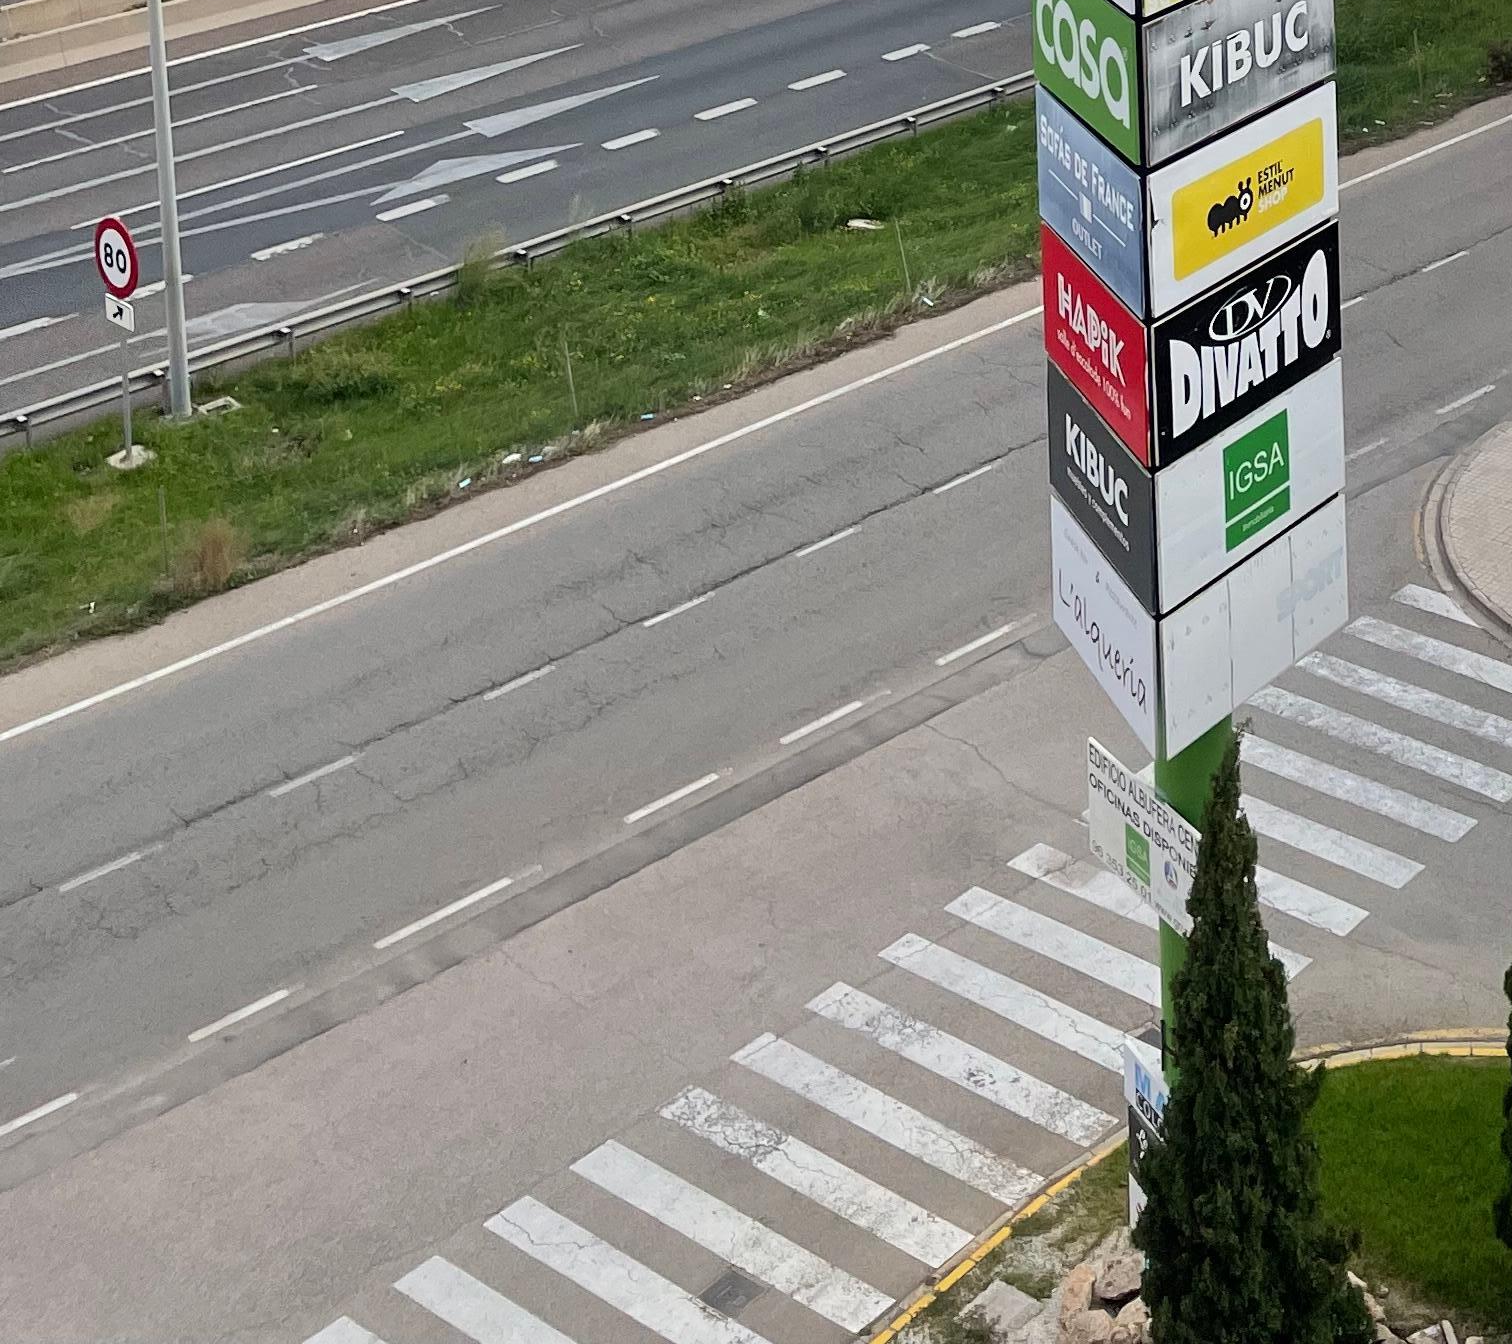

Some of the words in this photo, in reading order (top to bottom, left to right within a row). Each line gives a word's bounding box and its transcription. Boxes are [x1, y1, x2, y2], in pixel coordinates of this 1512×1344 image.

[1180, 0, 1310, 108] KIBUC
[1074, 152, 1088, 188] DE
[1091, 163, 1135, 232] FRANCE
[1257, 161, 1283, 185] ESTIL
[1258, 167, 1295, 200] MENUT
[103, 241, 127, 275] 80
[1072, 217, 1103, 260] OUTLET
[1169, 250, 1329, 439] DIVATTO
[1065, 413, 1129, 527] KIBUC
[1228, 442, 1284, 500] IGSA
[1089, 743, 1128, 792] EDIFICIO
[1128, 780, 1176, 834] ALBUFERA
[1089, 772, 1141, 828] OFICINAS
